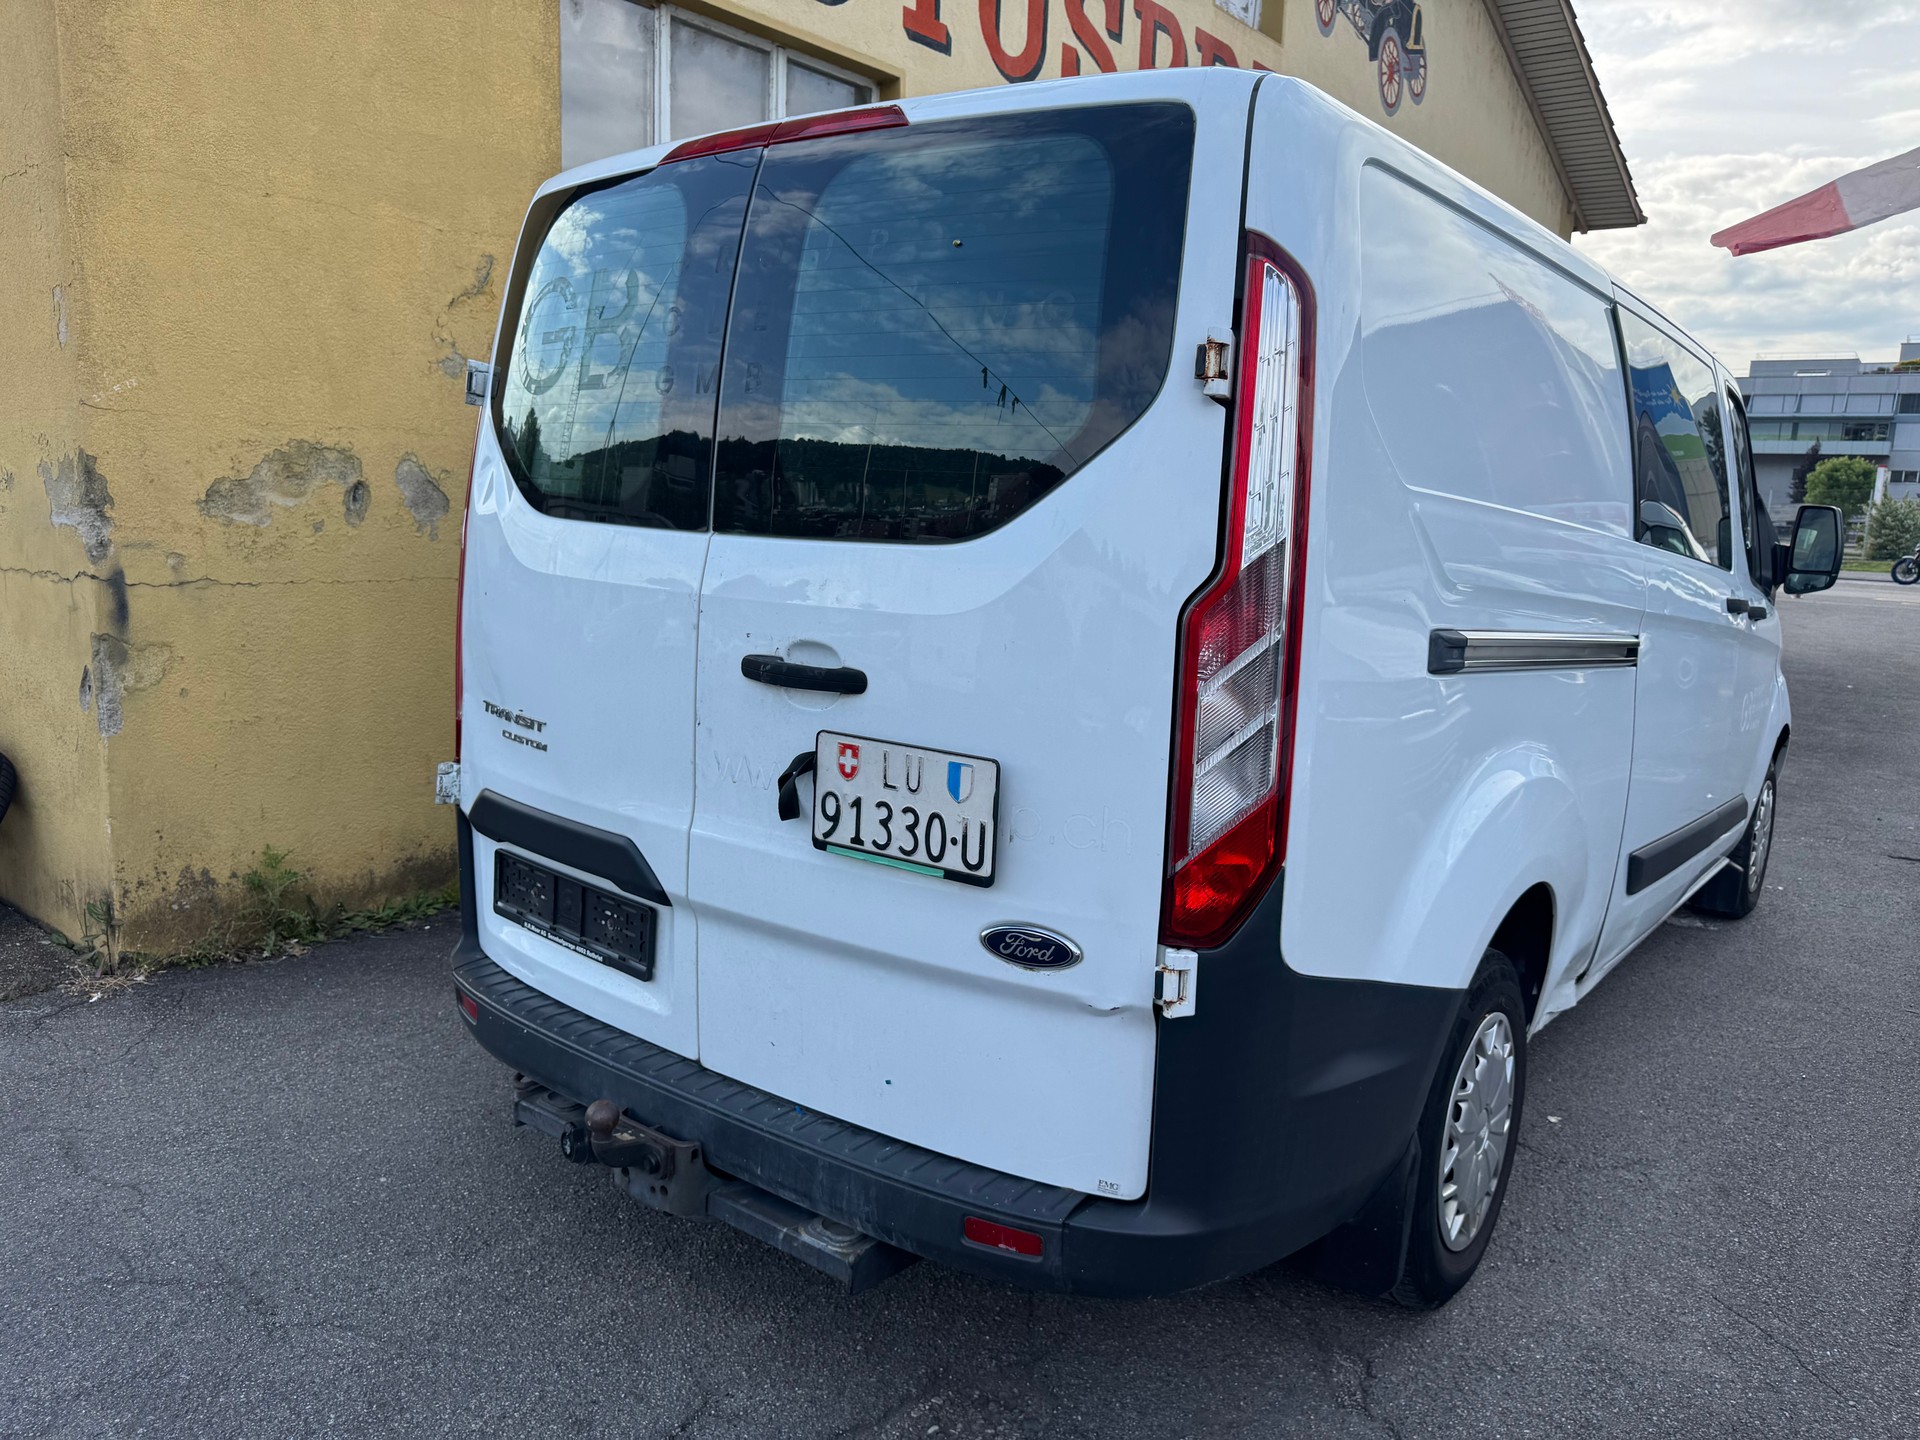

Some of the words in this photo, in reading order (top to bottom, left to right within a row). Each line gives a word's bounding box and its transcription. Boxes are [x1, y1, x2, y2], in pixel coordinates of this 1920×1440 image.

[483, 700, 547, 733] TRANSIT
[502, 729, 548, 752] CUSTOM
[883, 750, 924, 795] LU
[999, 931, 1055, 963] Ford
